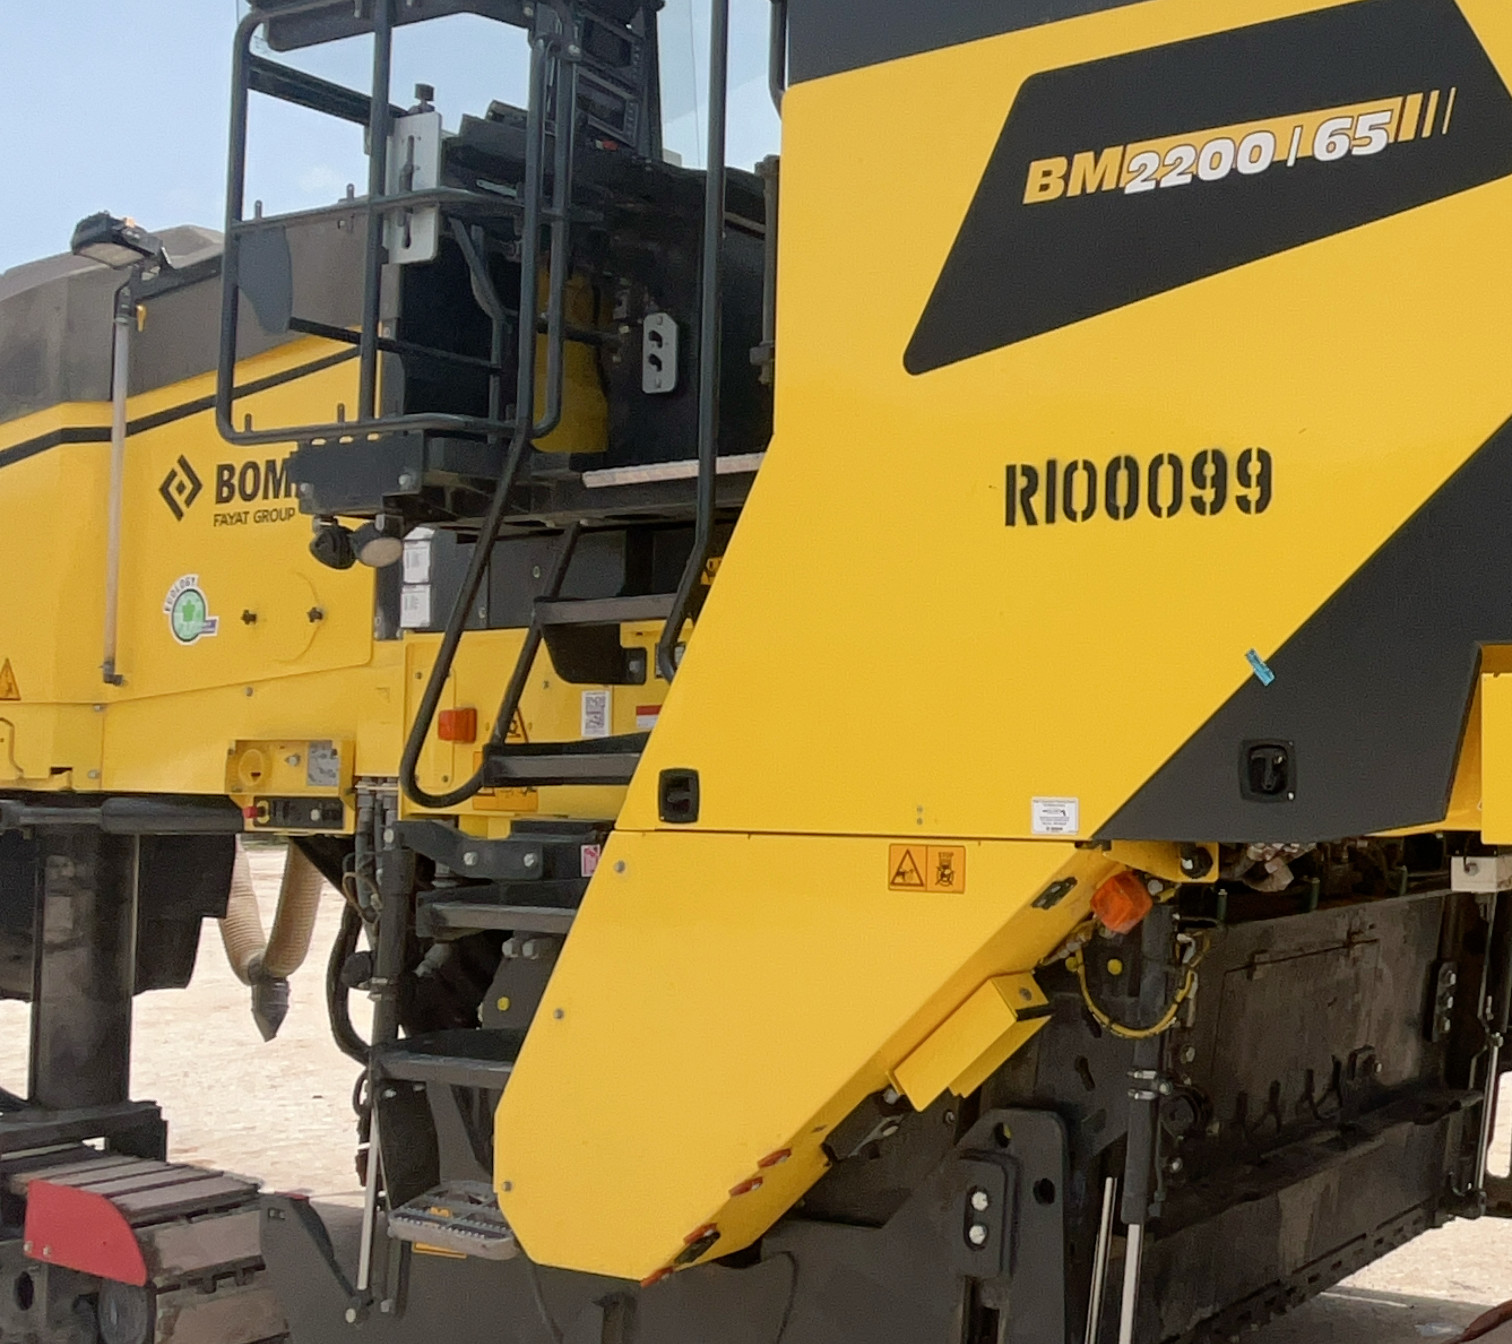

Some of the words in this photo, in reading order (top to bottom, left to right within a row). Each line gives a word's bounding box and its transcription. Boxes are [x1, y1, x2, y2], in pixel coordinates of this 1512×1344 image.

[215, 458, 300, 505] BOM
[213, 511, 250, 527] FAYAT
[253, 507, 296, 524] GROUP
